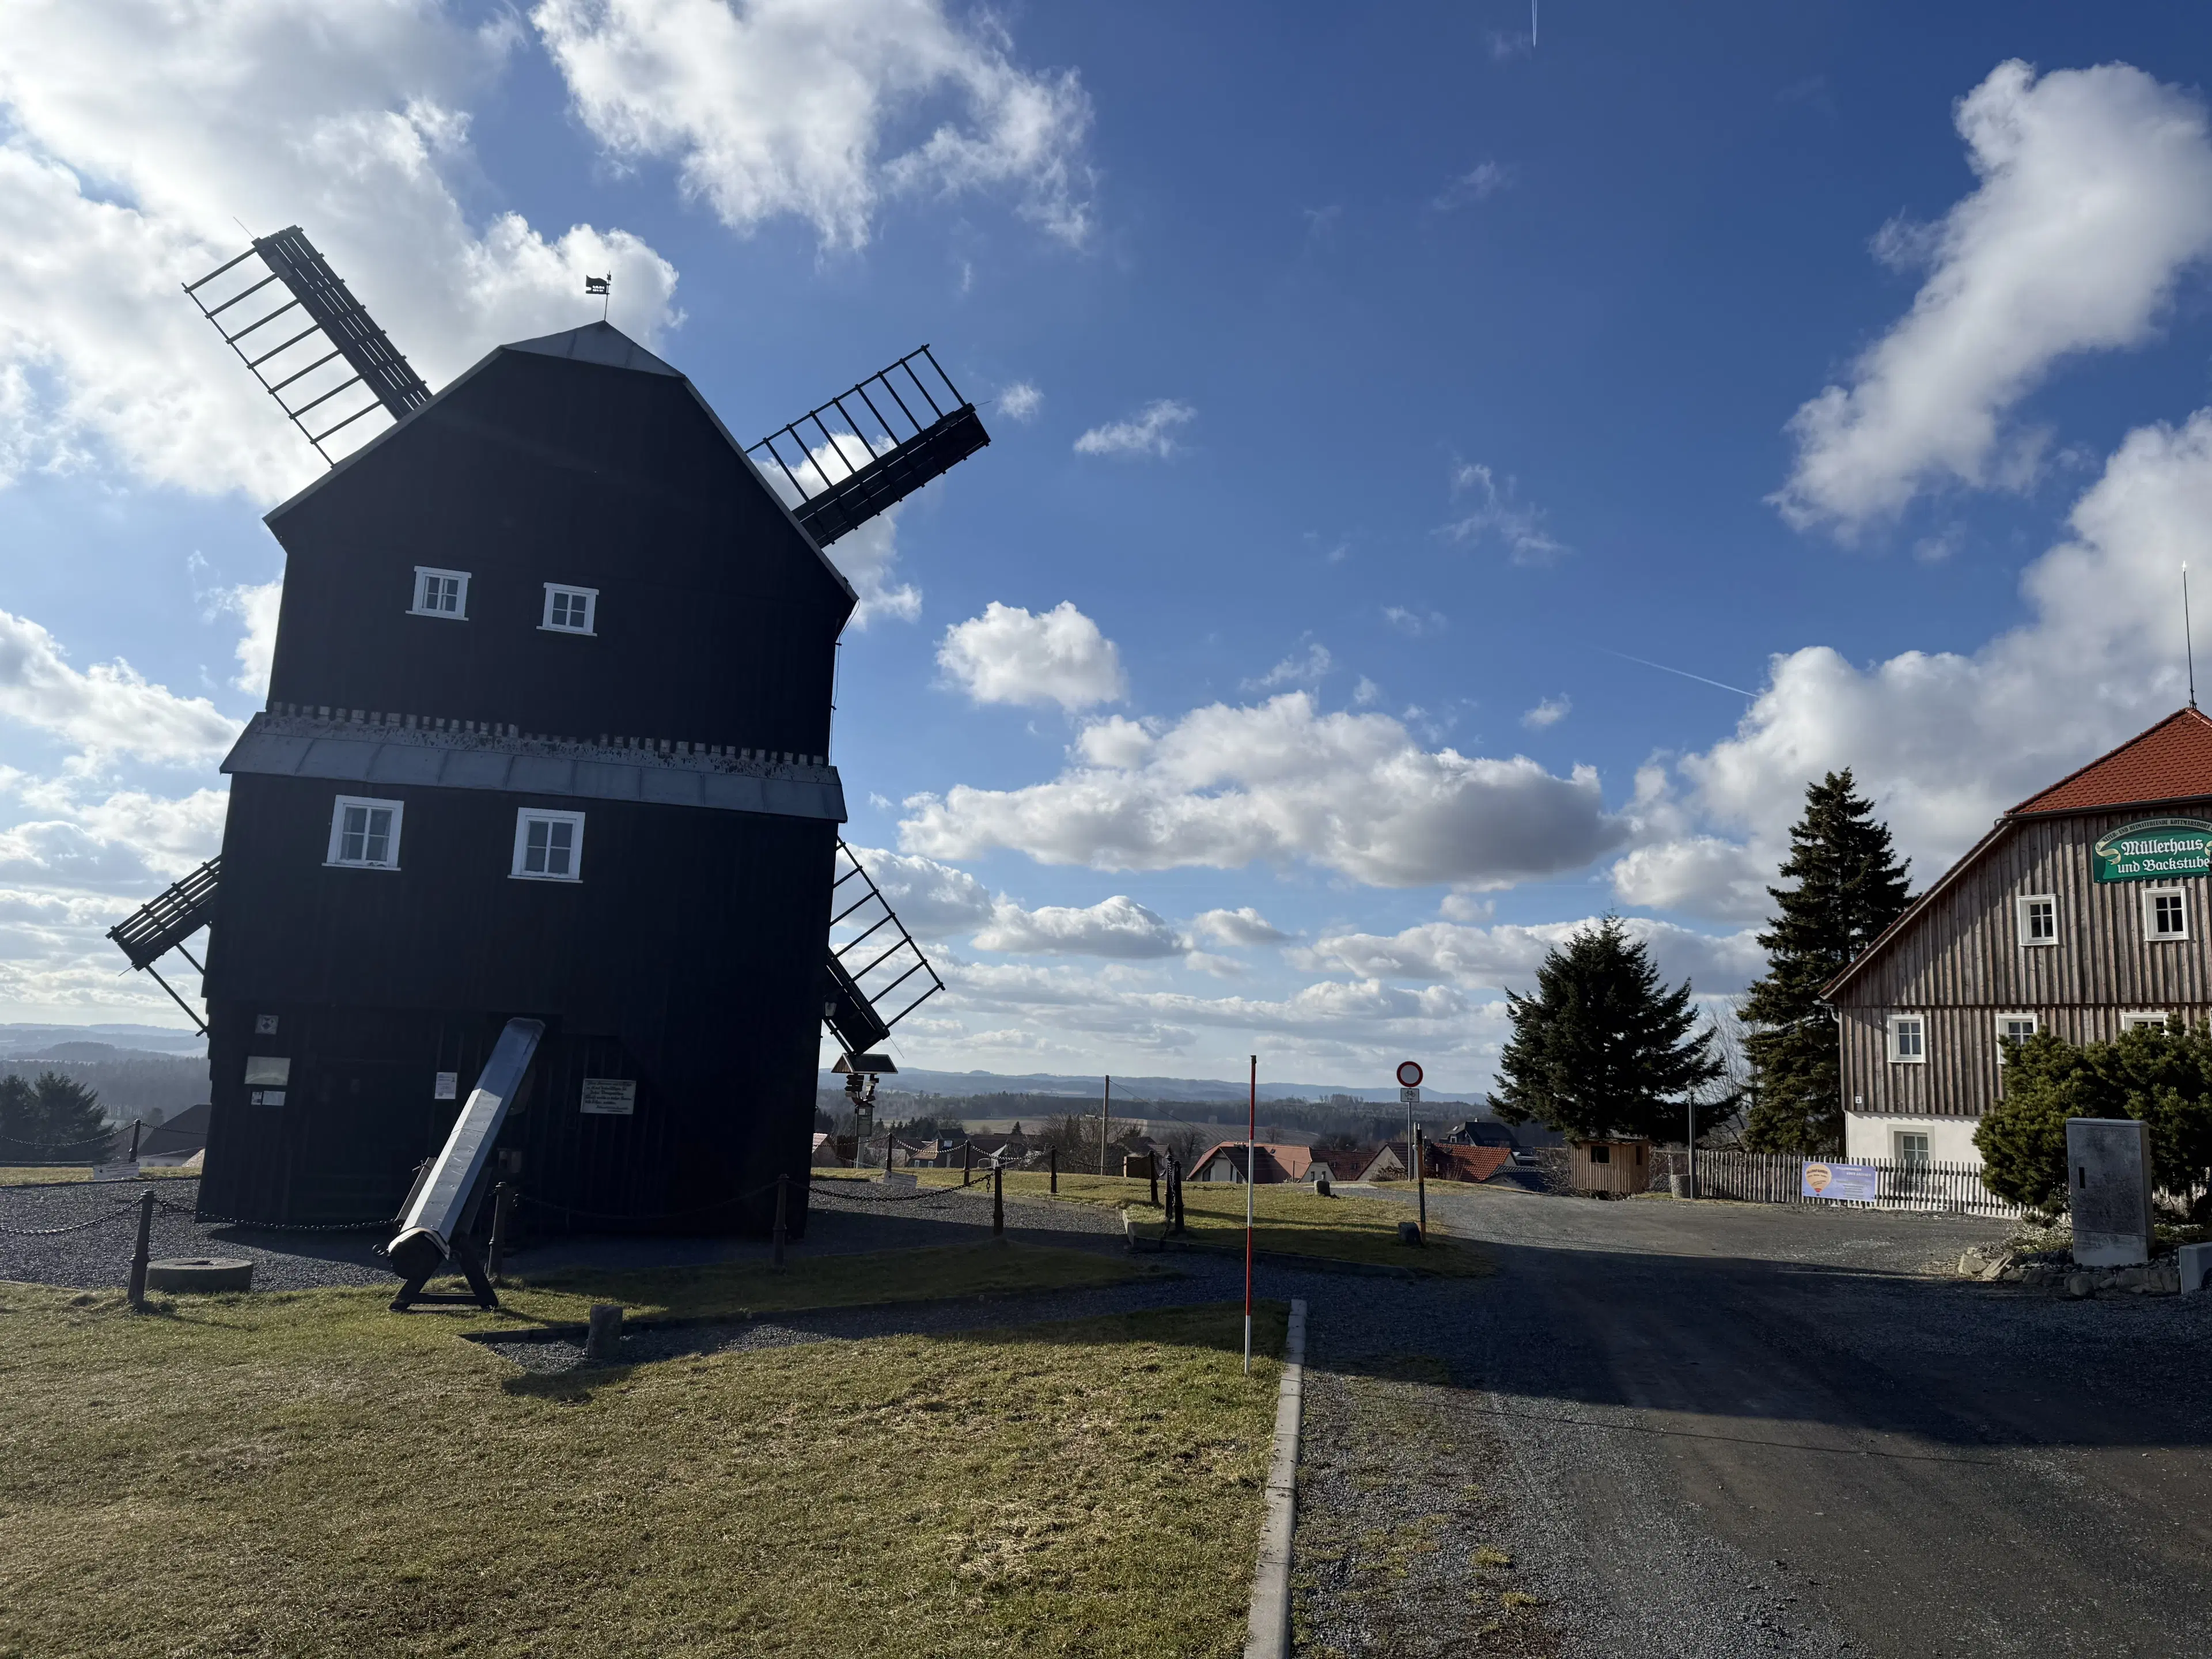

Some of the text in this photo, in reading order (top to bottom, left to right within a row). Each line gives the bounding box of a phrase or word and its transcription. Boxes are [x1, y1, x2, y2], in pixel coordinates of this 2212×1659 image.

[2171, 819, 2211, 829] KOTTMARSDORF
[2121, 838, 2203, 856] Müllerhaus
[2118, 856, 2210, 873] und Backstube
